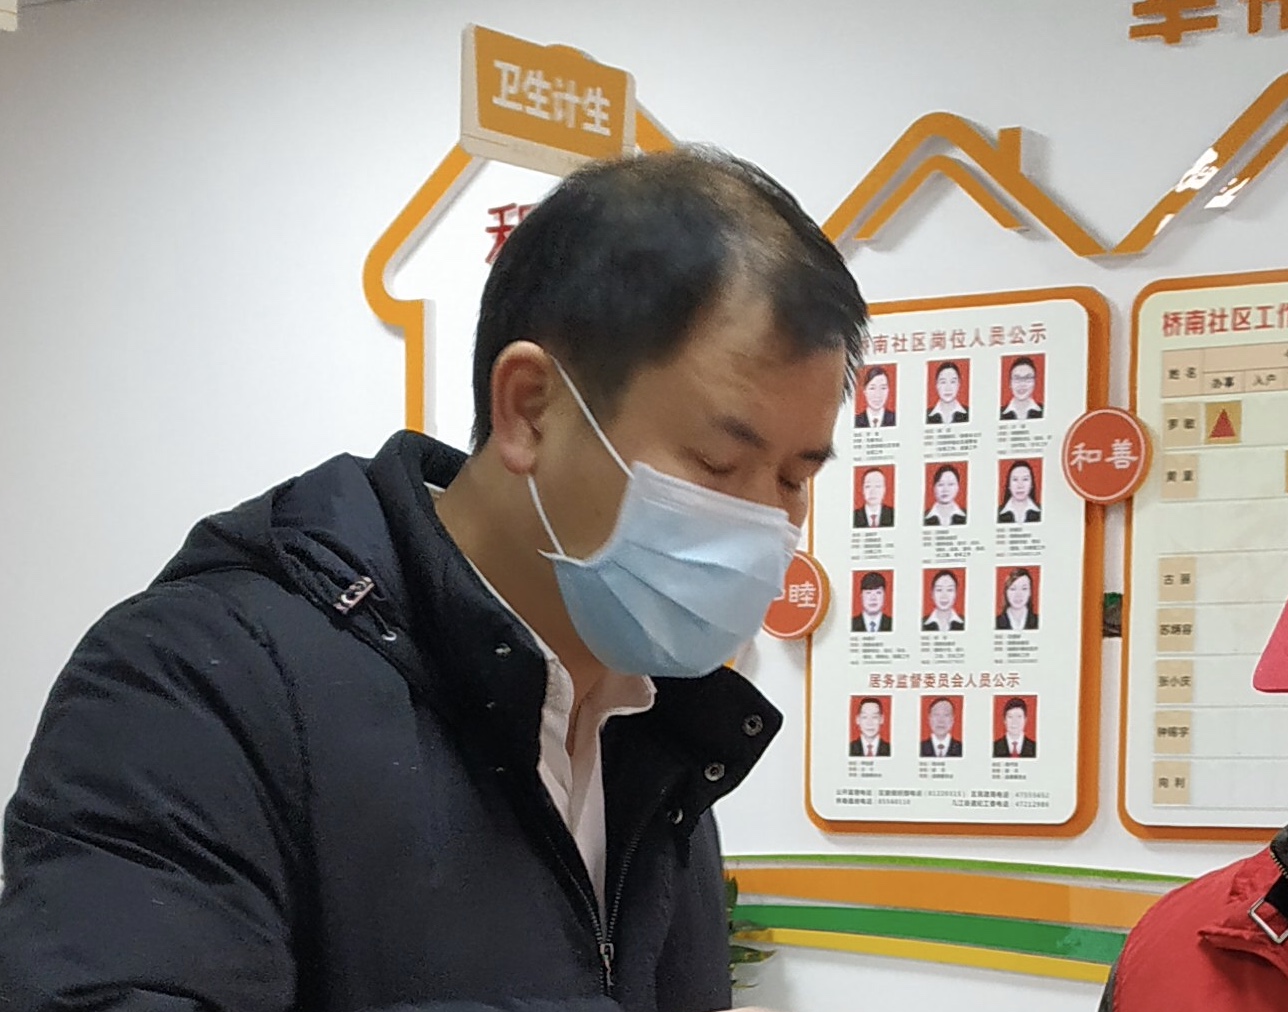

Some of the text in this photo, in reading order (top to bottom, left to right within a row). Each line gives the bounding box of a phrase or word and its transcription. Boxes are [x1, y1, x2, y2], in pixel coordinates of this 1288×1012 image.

[492, 60, 611, 136] 卫生计生
[1071, 437, 1139, 470] 和善
[868, 672, 1020, 689] 居务监督委员会人员公示
